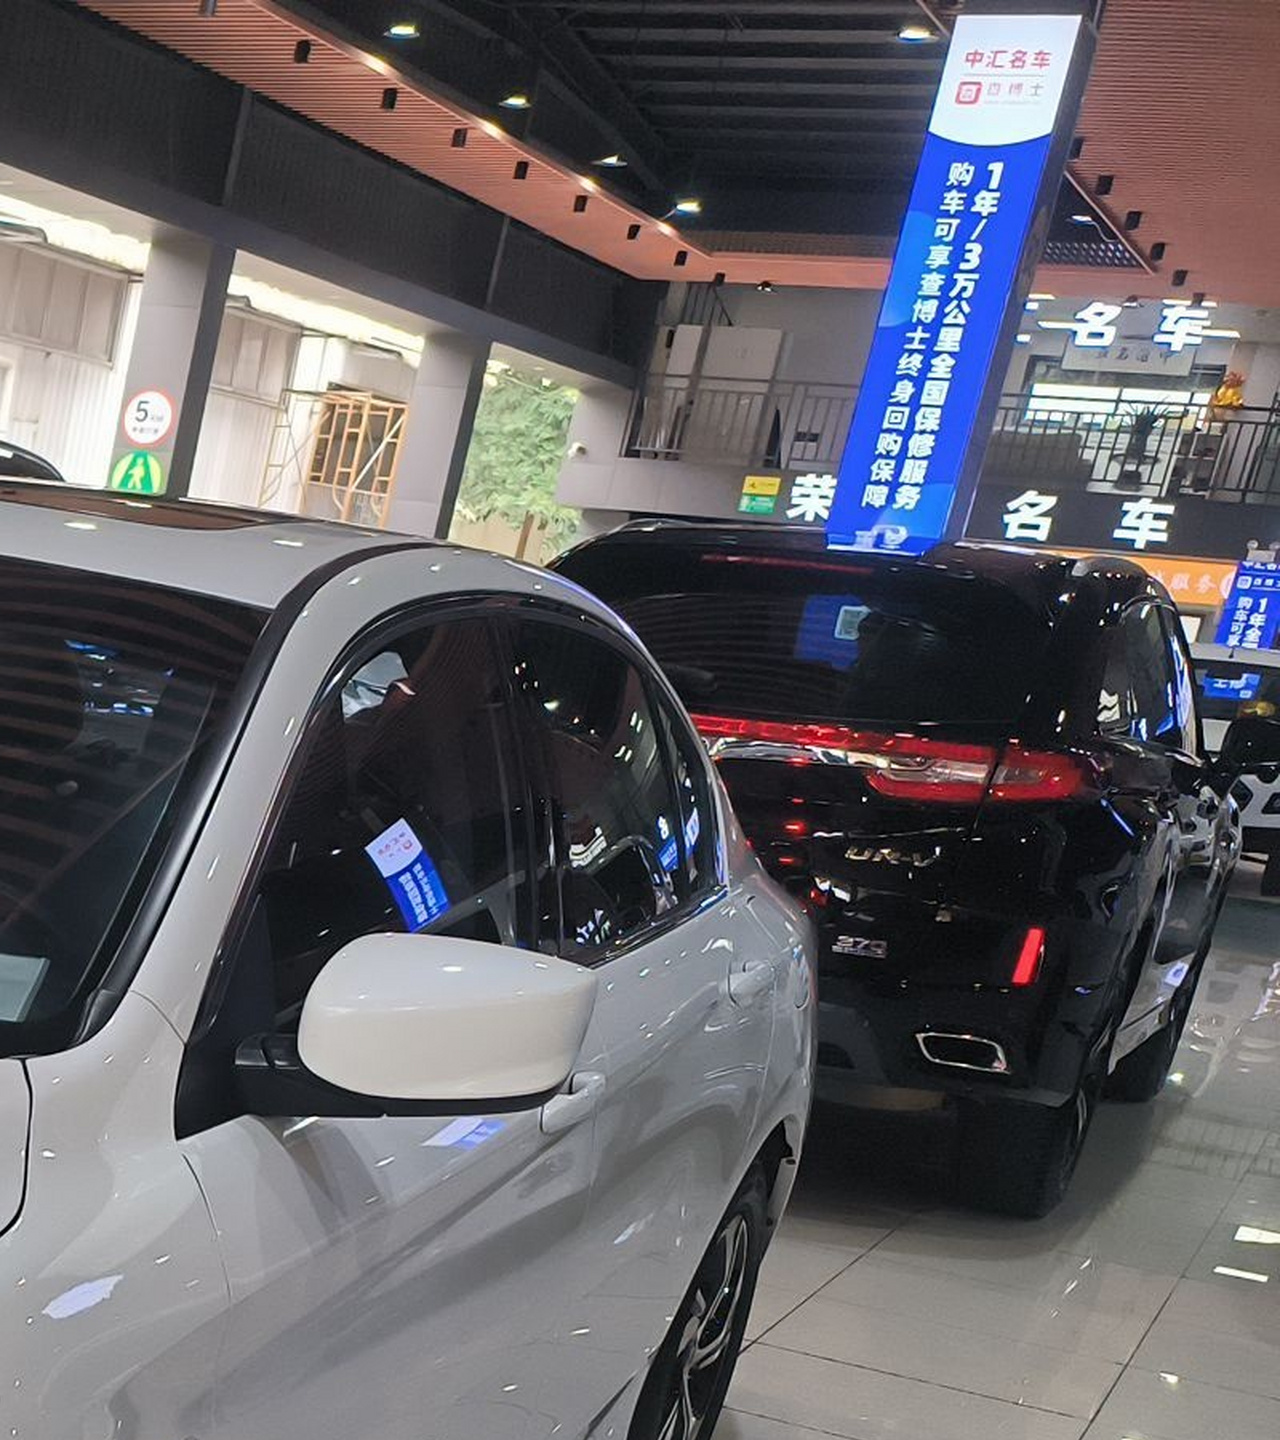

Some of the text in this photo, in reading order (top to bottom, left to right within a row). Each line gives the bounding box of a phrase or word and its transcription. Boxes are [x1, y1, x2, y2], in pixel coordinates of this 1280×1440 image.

[964, 49, 1052, 68] 中汇名车
[861, 161, 975, 509] 购车可享查博士终身回购保障
[1016, 301, 1212, 352] 名车
